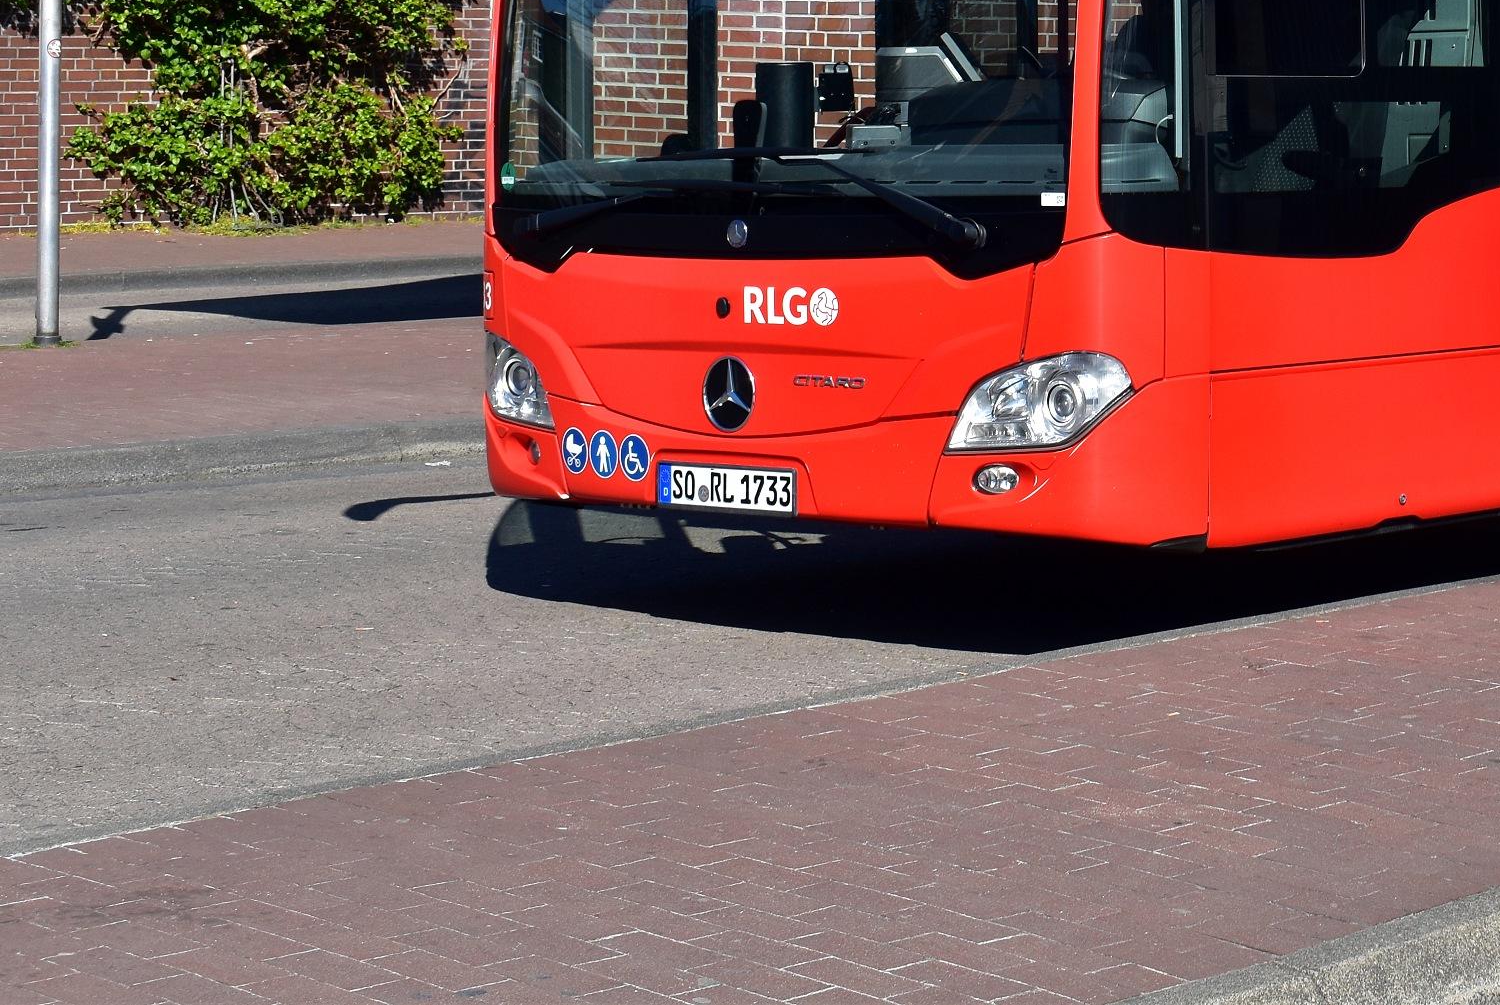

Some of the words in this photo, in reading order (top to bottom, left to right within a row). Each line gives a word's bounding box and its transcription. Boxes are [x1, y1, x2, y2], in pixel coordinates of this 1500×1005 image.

[743, 286, 808, 326] RLG
[793, 375, 866, 389] CITARO
[710, 472, 734, 503] RL
[740, 474, 791, 507] 1733
